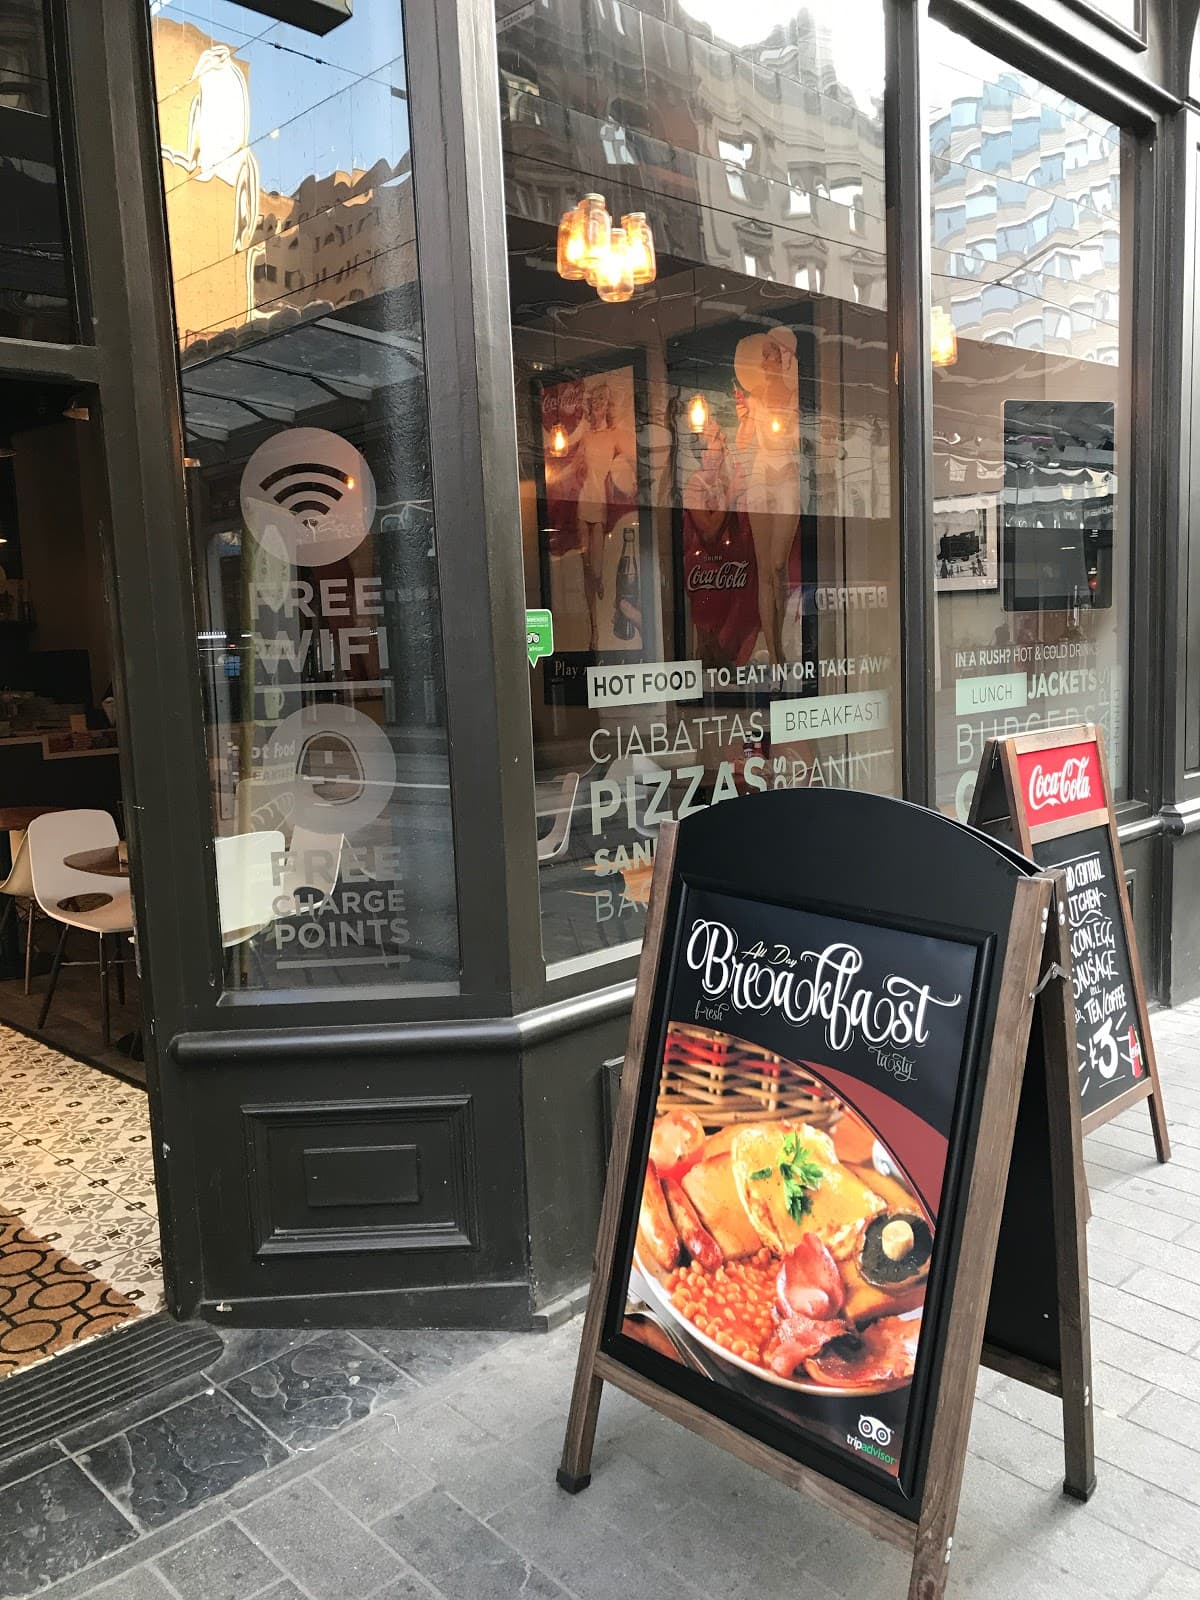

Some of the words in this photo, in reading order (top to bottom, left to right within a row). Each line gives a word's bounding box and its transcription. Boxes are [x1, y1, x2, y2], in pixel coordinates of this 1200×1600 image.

[687, 560, 750, 591] Coca-Cola
[248, 577, 385, 620] FREE
[250, 626, 389, 674] WIFI
[955, 651, 966, 668] IN
[968, 651, 977, 666] A
[979, 648, 1011, 666] RUSH?
[1013, 646, 1033, 663] HOT
[1034, 648, 1042, 661] &
[1043, 644, 1068, 660] COLD
[554, 660, 578, 679] Play
[593, 674, 636, 697] HOT
[642, 670, 697, 694] FOOD
[707, 667, 731, 688] TO
[736, 664, 767, 686] EAT
[772, 662, 788, 682] IN
[793, 661, 816, 681] OR
[818, 657, 856, 679] TAKE
[971, 683, 1013, 705] LUNCH
[1028, 667, 1097, 700] JACKETS
[785, 701, 882, 732] BREAKFAST
[589, 711, 764, 764] CIABATTAS
[590, 756, 767, 836] PIZZAS
[1029, 755, 1091, 811] Coca-Cola
[270, 846, 403, 886] FREE
[1075, 857, 1105, 887] CENTRAL
[272, 889, 406, 917] CHARGE
[1068, 887, 1104, 921] ITCHEN
[275, 918, 411, 950] POINTS
[740, 941, 768, 961] All
[767, 944, 798, 968] Day
[686, 918, 962, 1051] Breakfast
[694, 999, 730, 1022] fresh
[868, 1046, 918, 1082] tasty
[846, 1433, 896, 1465] tripadvisor
